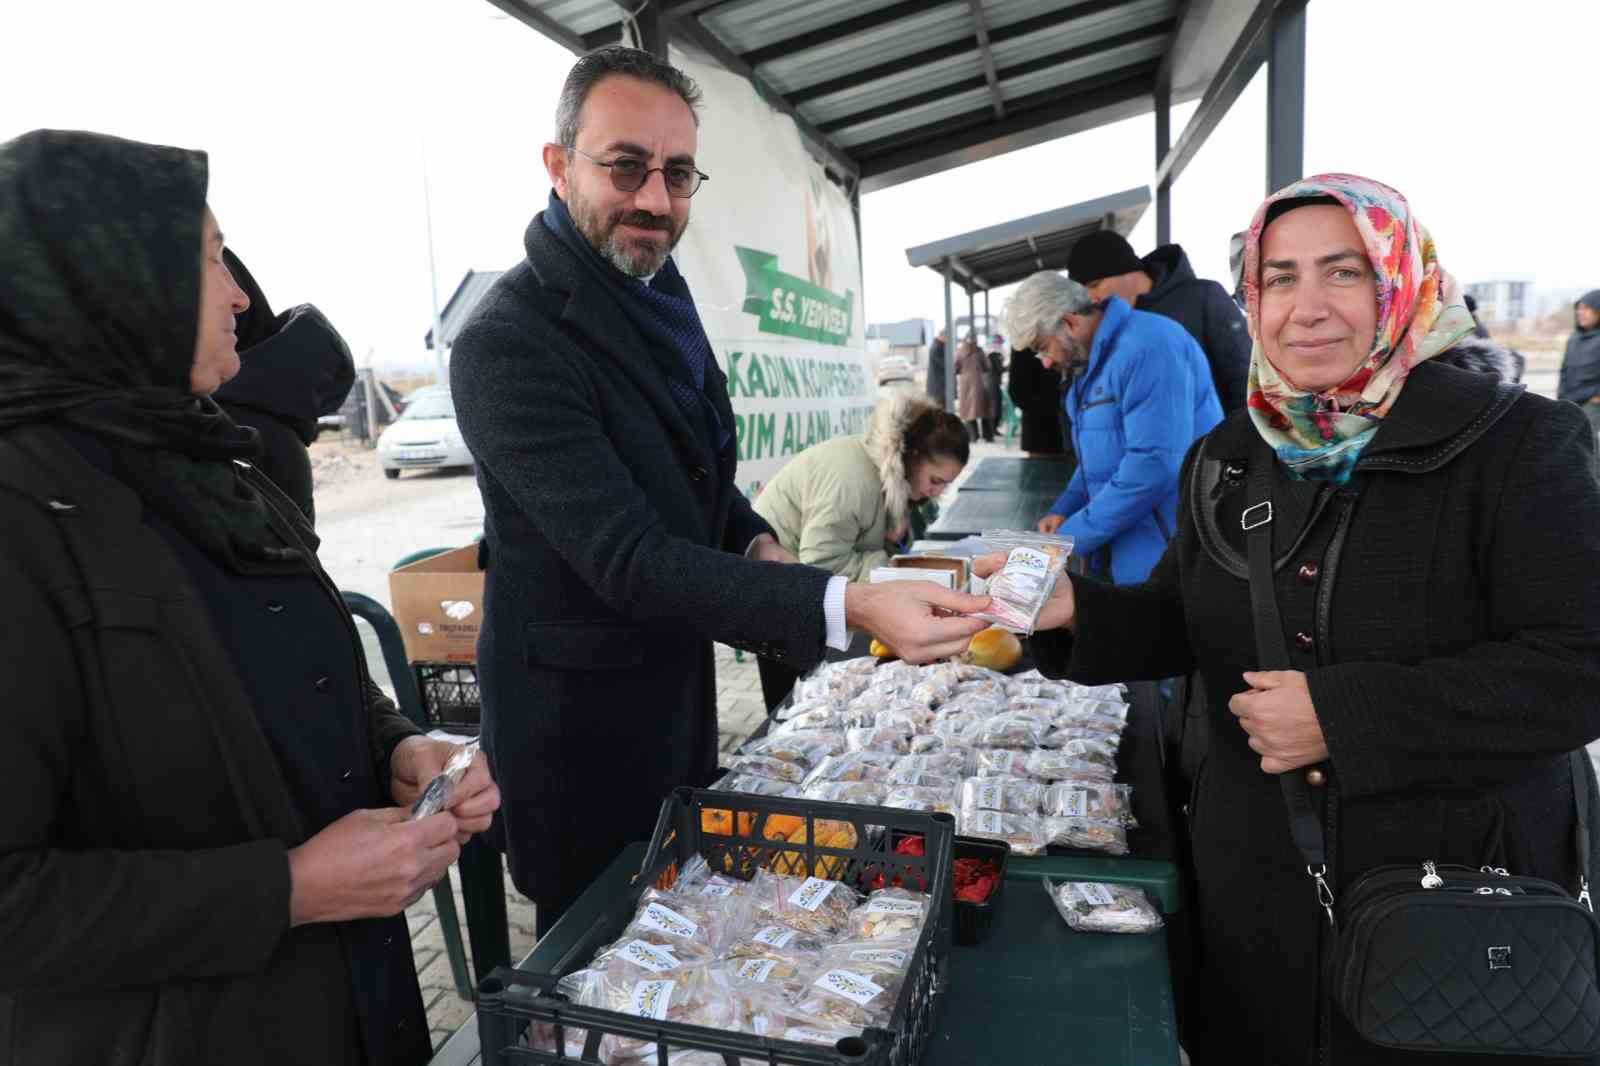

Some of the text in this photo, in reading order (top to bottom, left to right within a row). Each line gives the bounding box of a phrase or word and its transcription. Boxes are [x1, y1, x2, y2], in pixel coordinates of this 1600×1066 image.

[769, 287, 797, 323] S.S.
[726, 352, 799, 398] KADIN
[781, 409, 832, 455] ALANI
